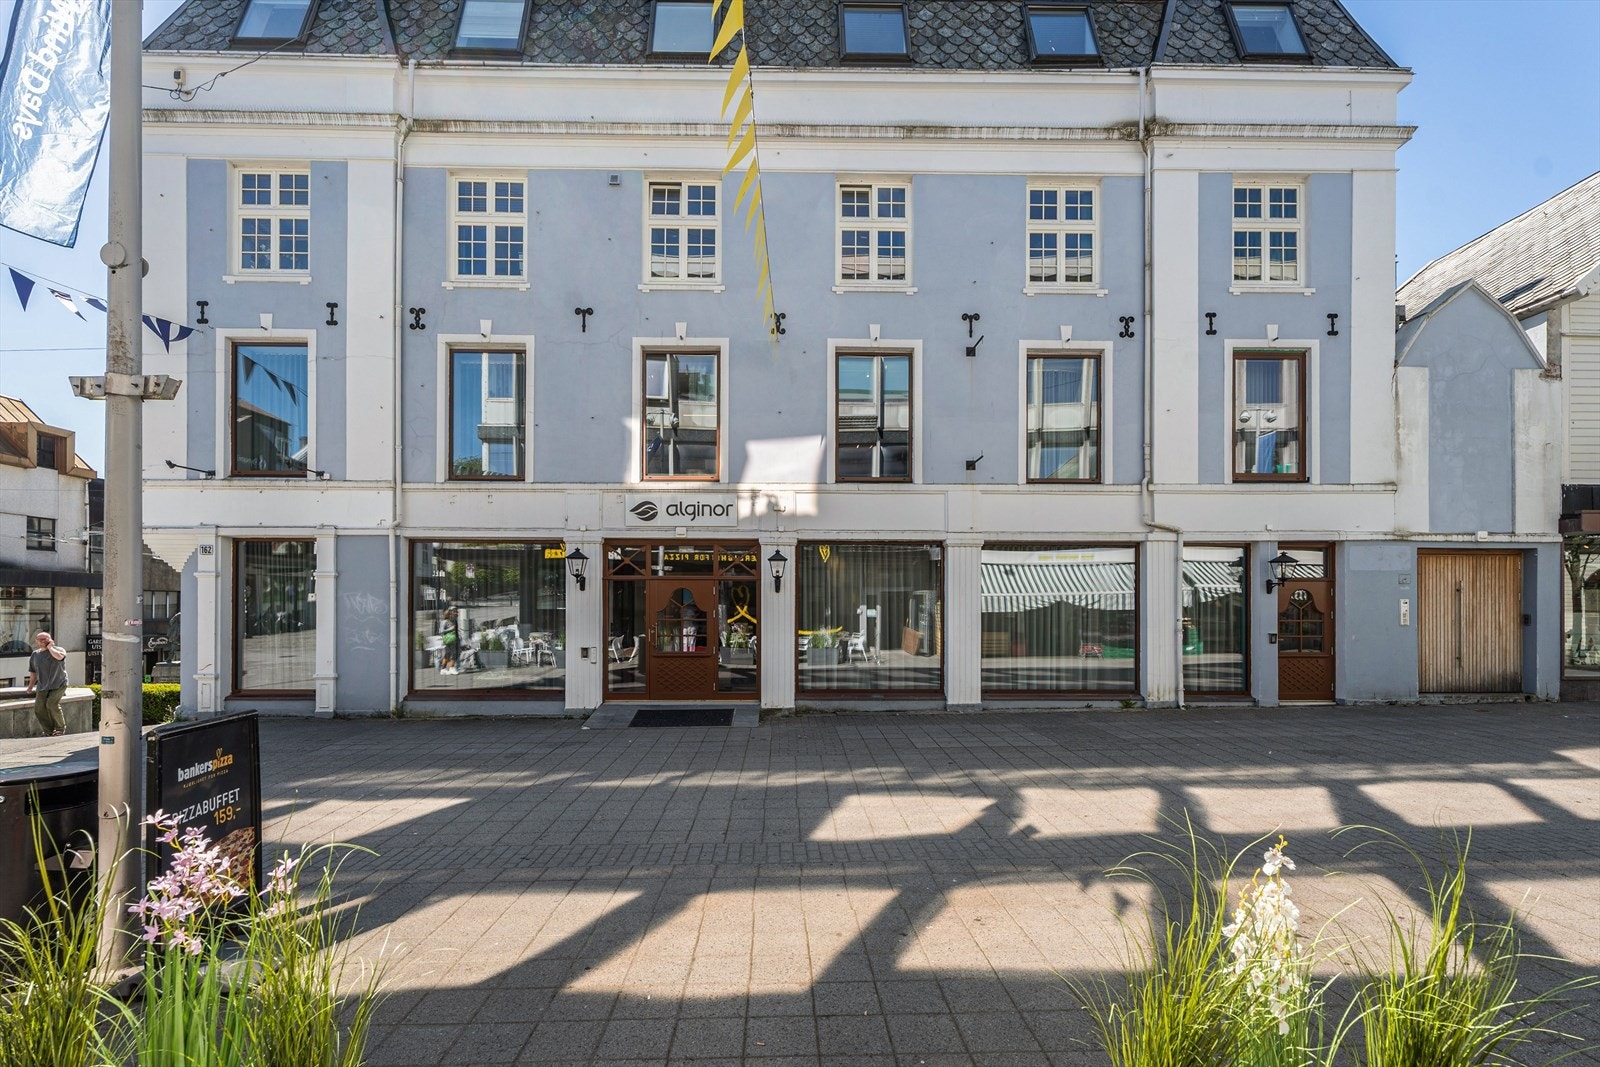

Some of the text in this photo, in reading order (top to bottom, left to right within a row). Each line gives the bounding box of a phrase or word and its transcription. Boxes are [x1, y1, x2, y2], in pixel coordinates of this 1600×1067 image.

[665, 501, 734, 522] alginor
[200, 545, 212, 554] 162
[178, 753, 233, 782] bankerspizza
